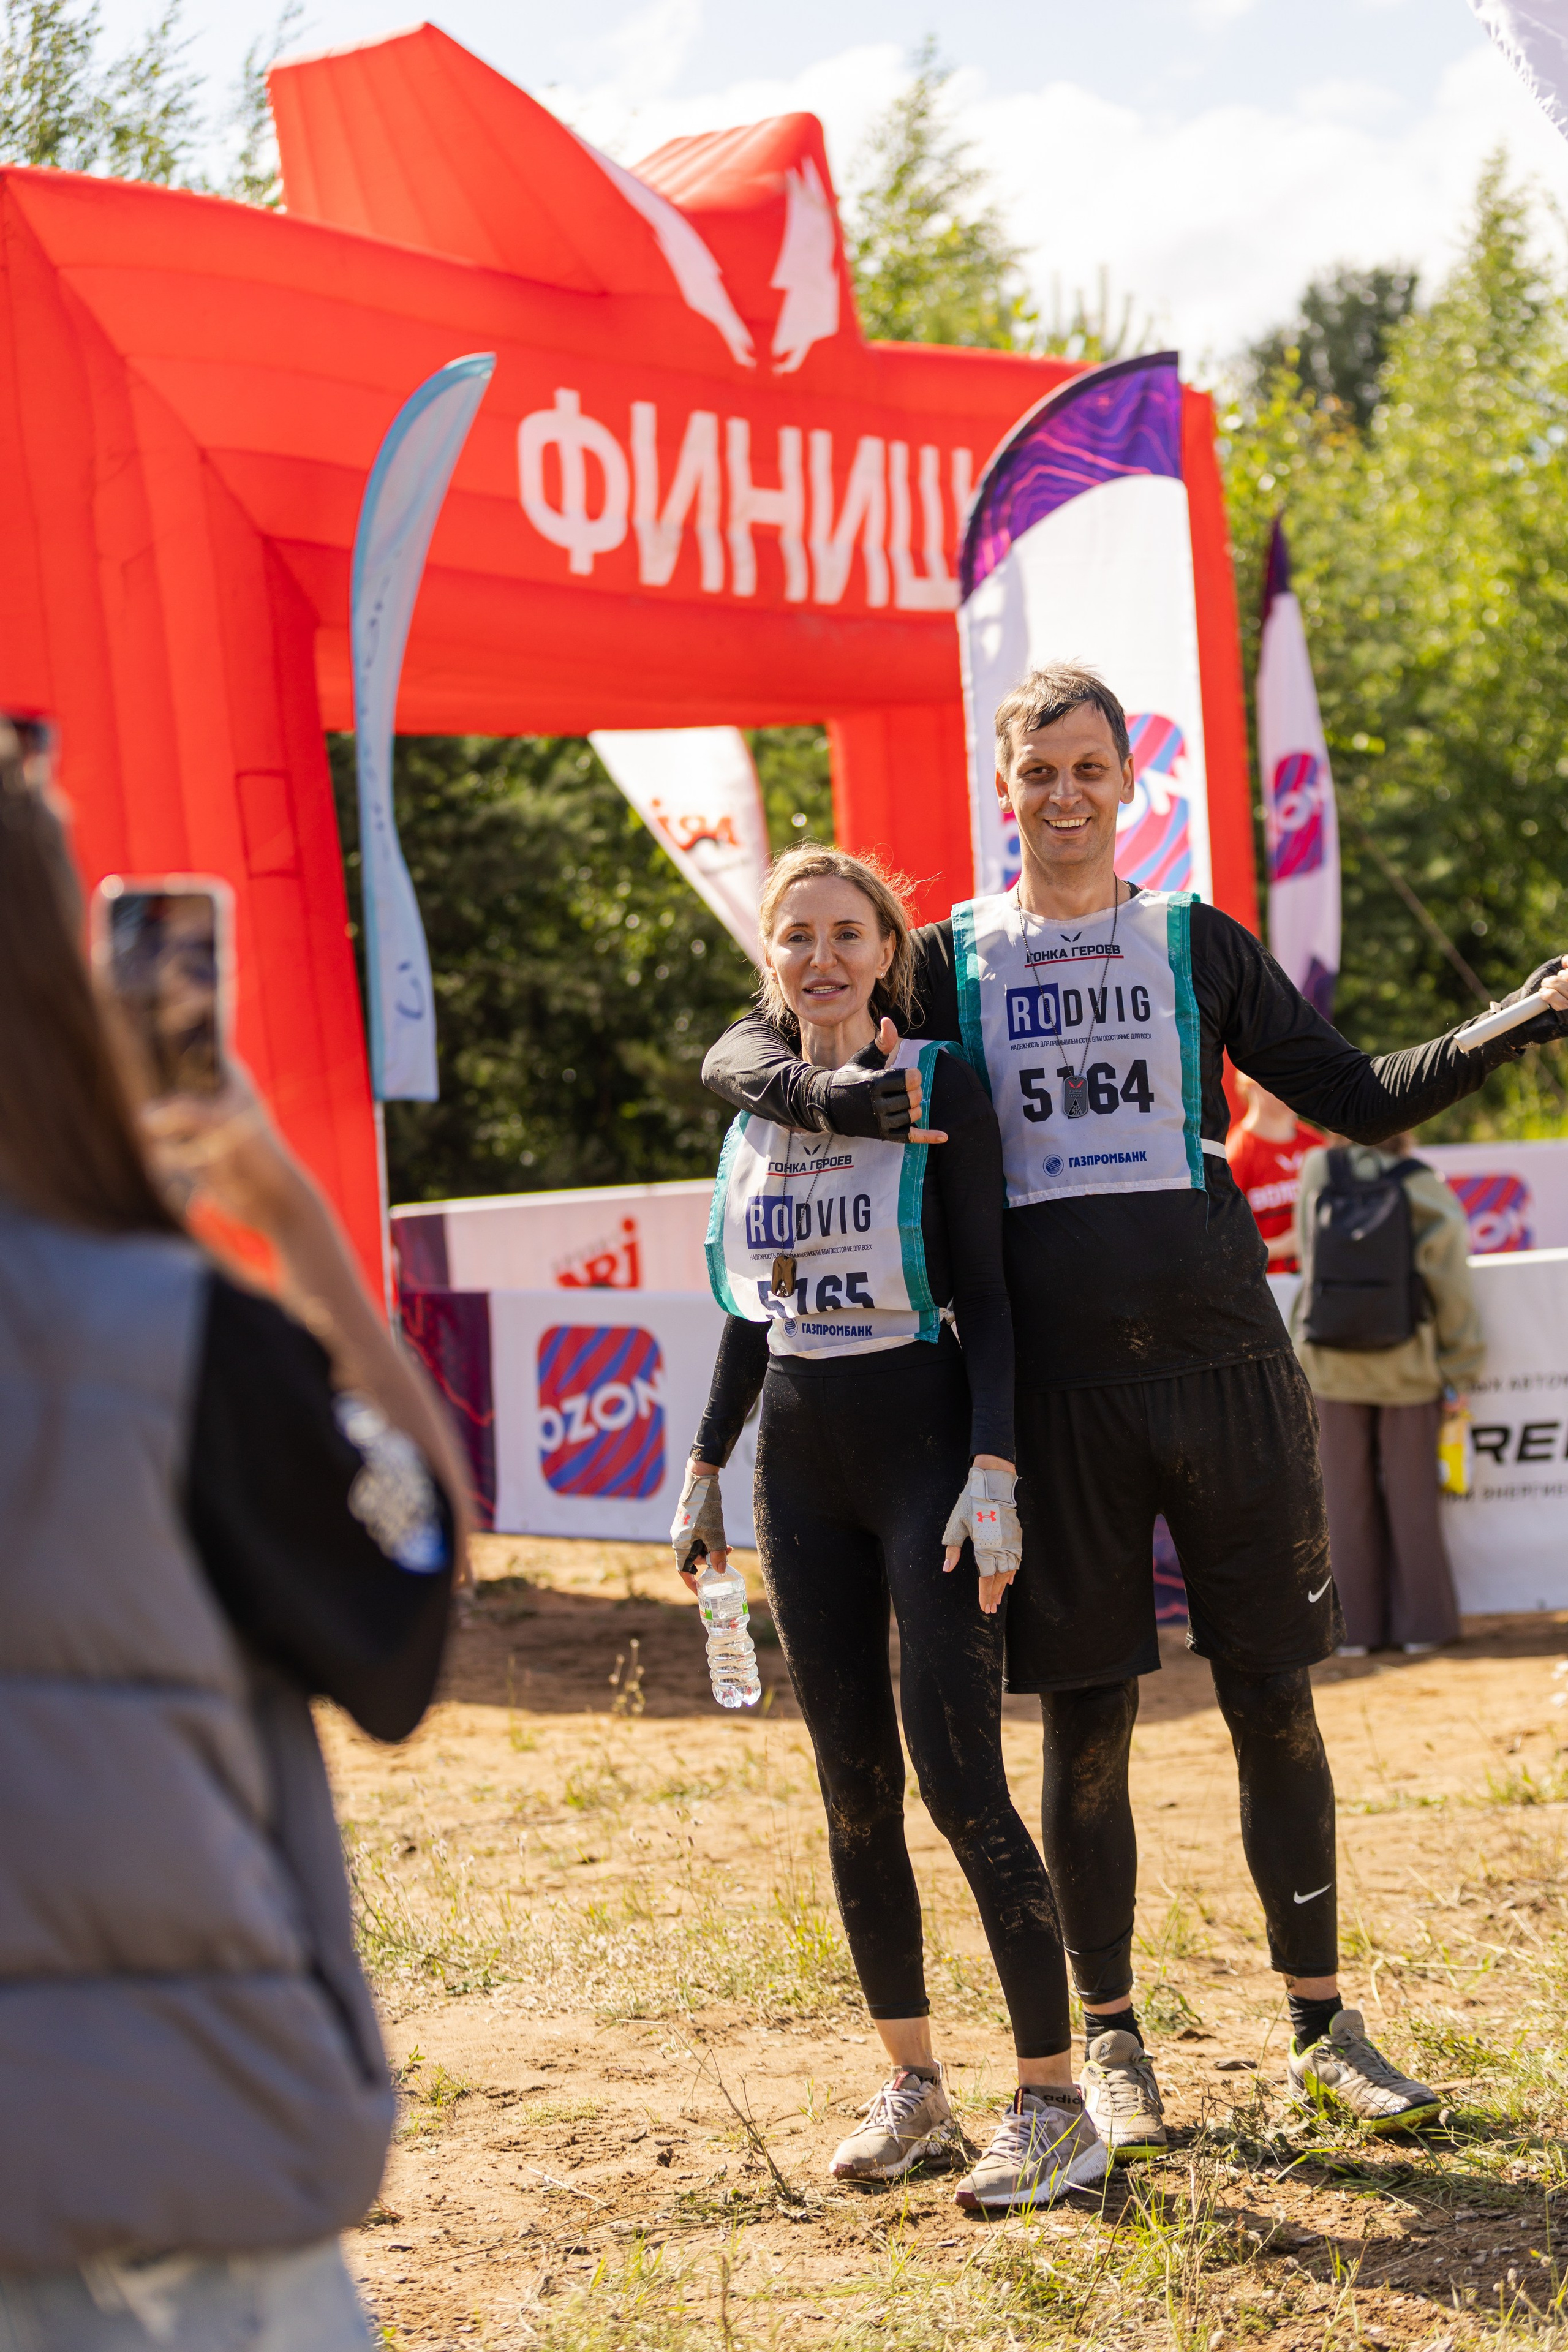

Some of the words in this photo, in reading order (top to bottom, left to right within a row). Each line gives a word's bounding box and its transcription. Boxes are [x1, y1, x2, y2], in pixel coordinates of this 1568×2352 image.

[517, 386, 974, 612] ФИНИШ
[1026, 948, 1068, 963] ГОНКА
[1071, 944, 1121, 957] ГЕРОЕВ
[1012, 985, 1151, 1033] RODVIG
[1011, 1042, 1039, 1050] НАДЕЖНОСТЬ
[1092, 1033, 1130, 1042] БЛАГОСОСТОЯНИЕ
[768, 1162, 807, 1173] ГОНКА
[810, 1155, 853, 1170] ГЕРОЕВ
[1068, 1151, 1147, 1168] ГАЗПРОМБАНК
[750, 1194, 871, 1242] RODVIG
[821, 1246, 853, 1255] БЛАГОСОСТОЯНИЕ
[802, 1322, 873, 1336] ГАЗПРОМБАНК
[537, 1371, 666, 1453] OZON
[1471, 1421, 1568, 1464] RE
